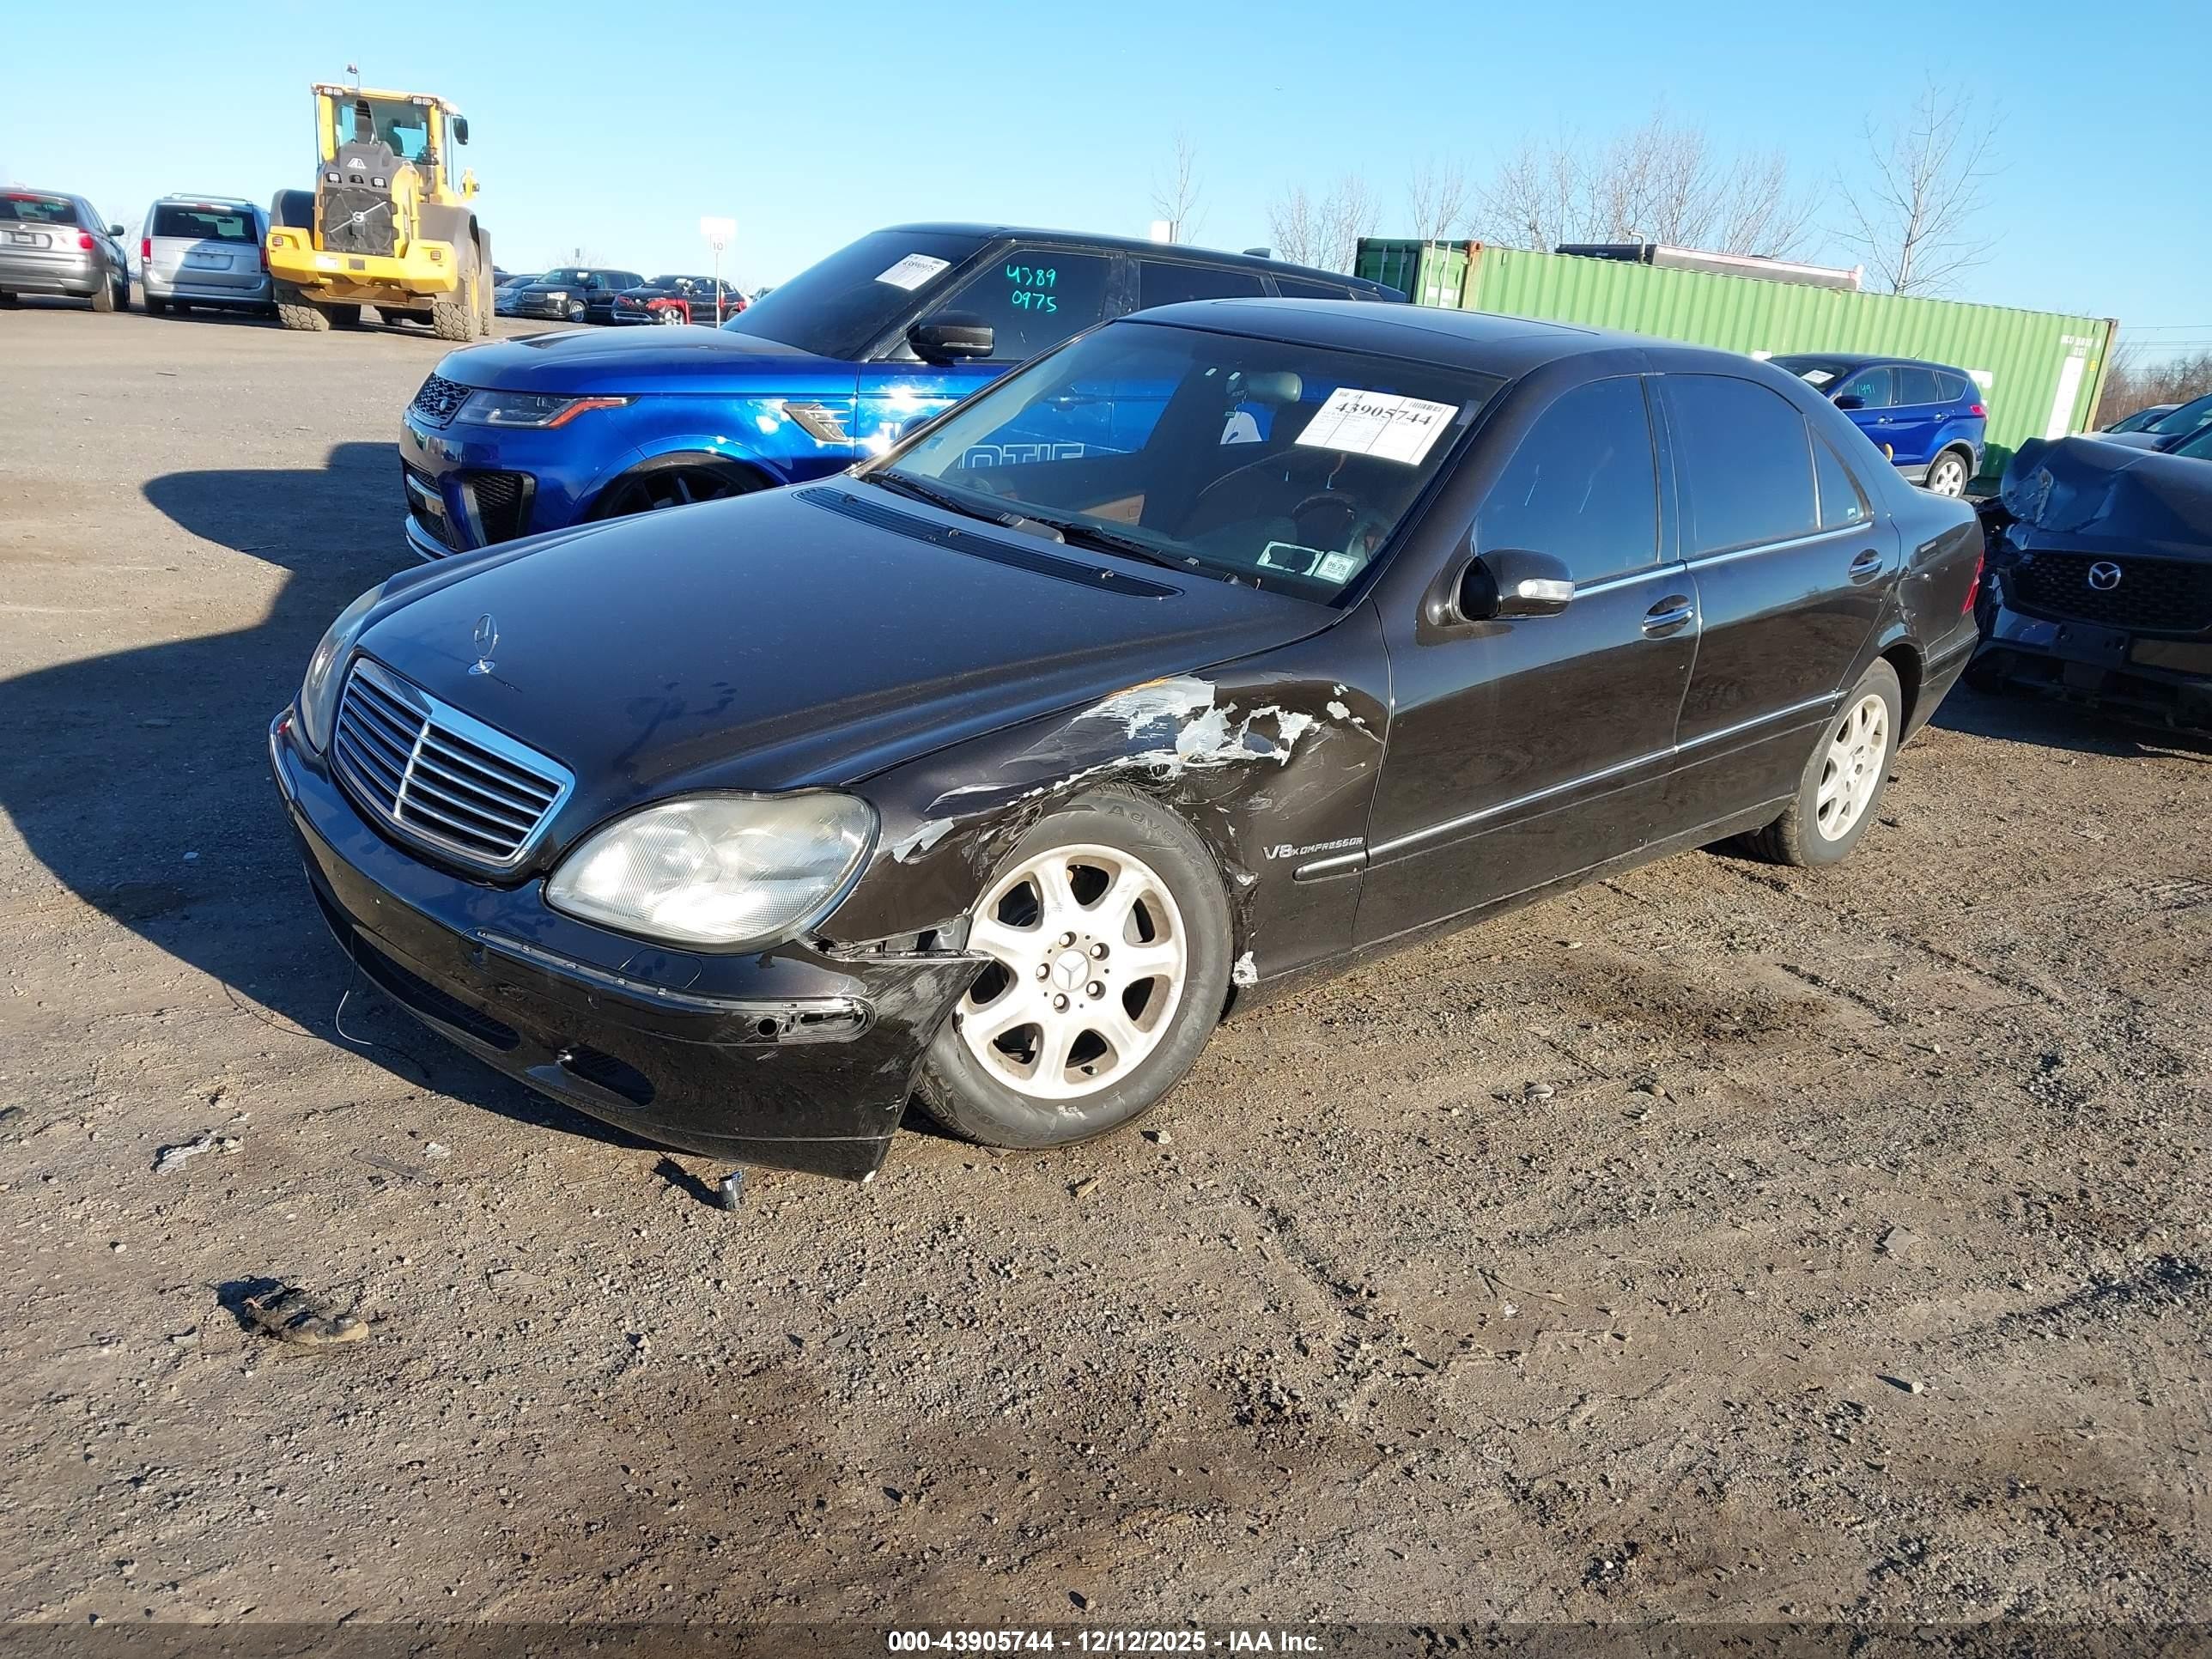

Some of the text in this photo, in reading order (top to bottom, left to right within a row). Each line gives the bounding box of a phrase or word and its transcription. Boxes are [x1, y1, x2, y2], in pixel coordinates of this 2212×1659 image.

[1006, 264, 1056, 288] 4389
[1012, 289, 1058, 313] 0975
[1856, 384, 1875, 396] 1491
[1335, 402, 1433, 426] 43905744
[1262, 836, 1364, 860] V8 KOMPRESSOR
